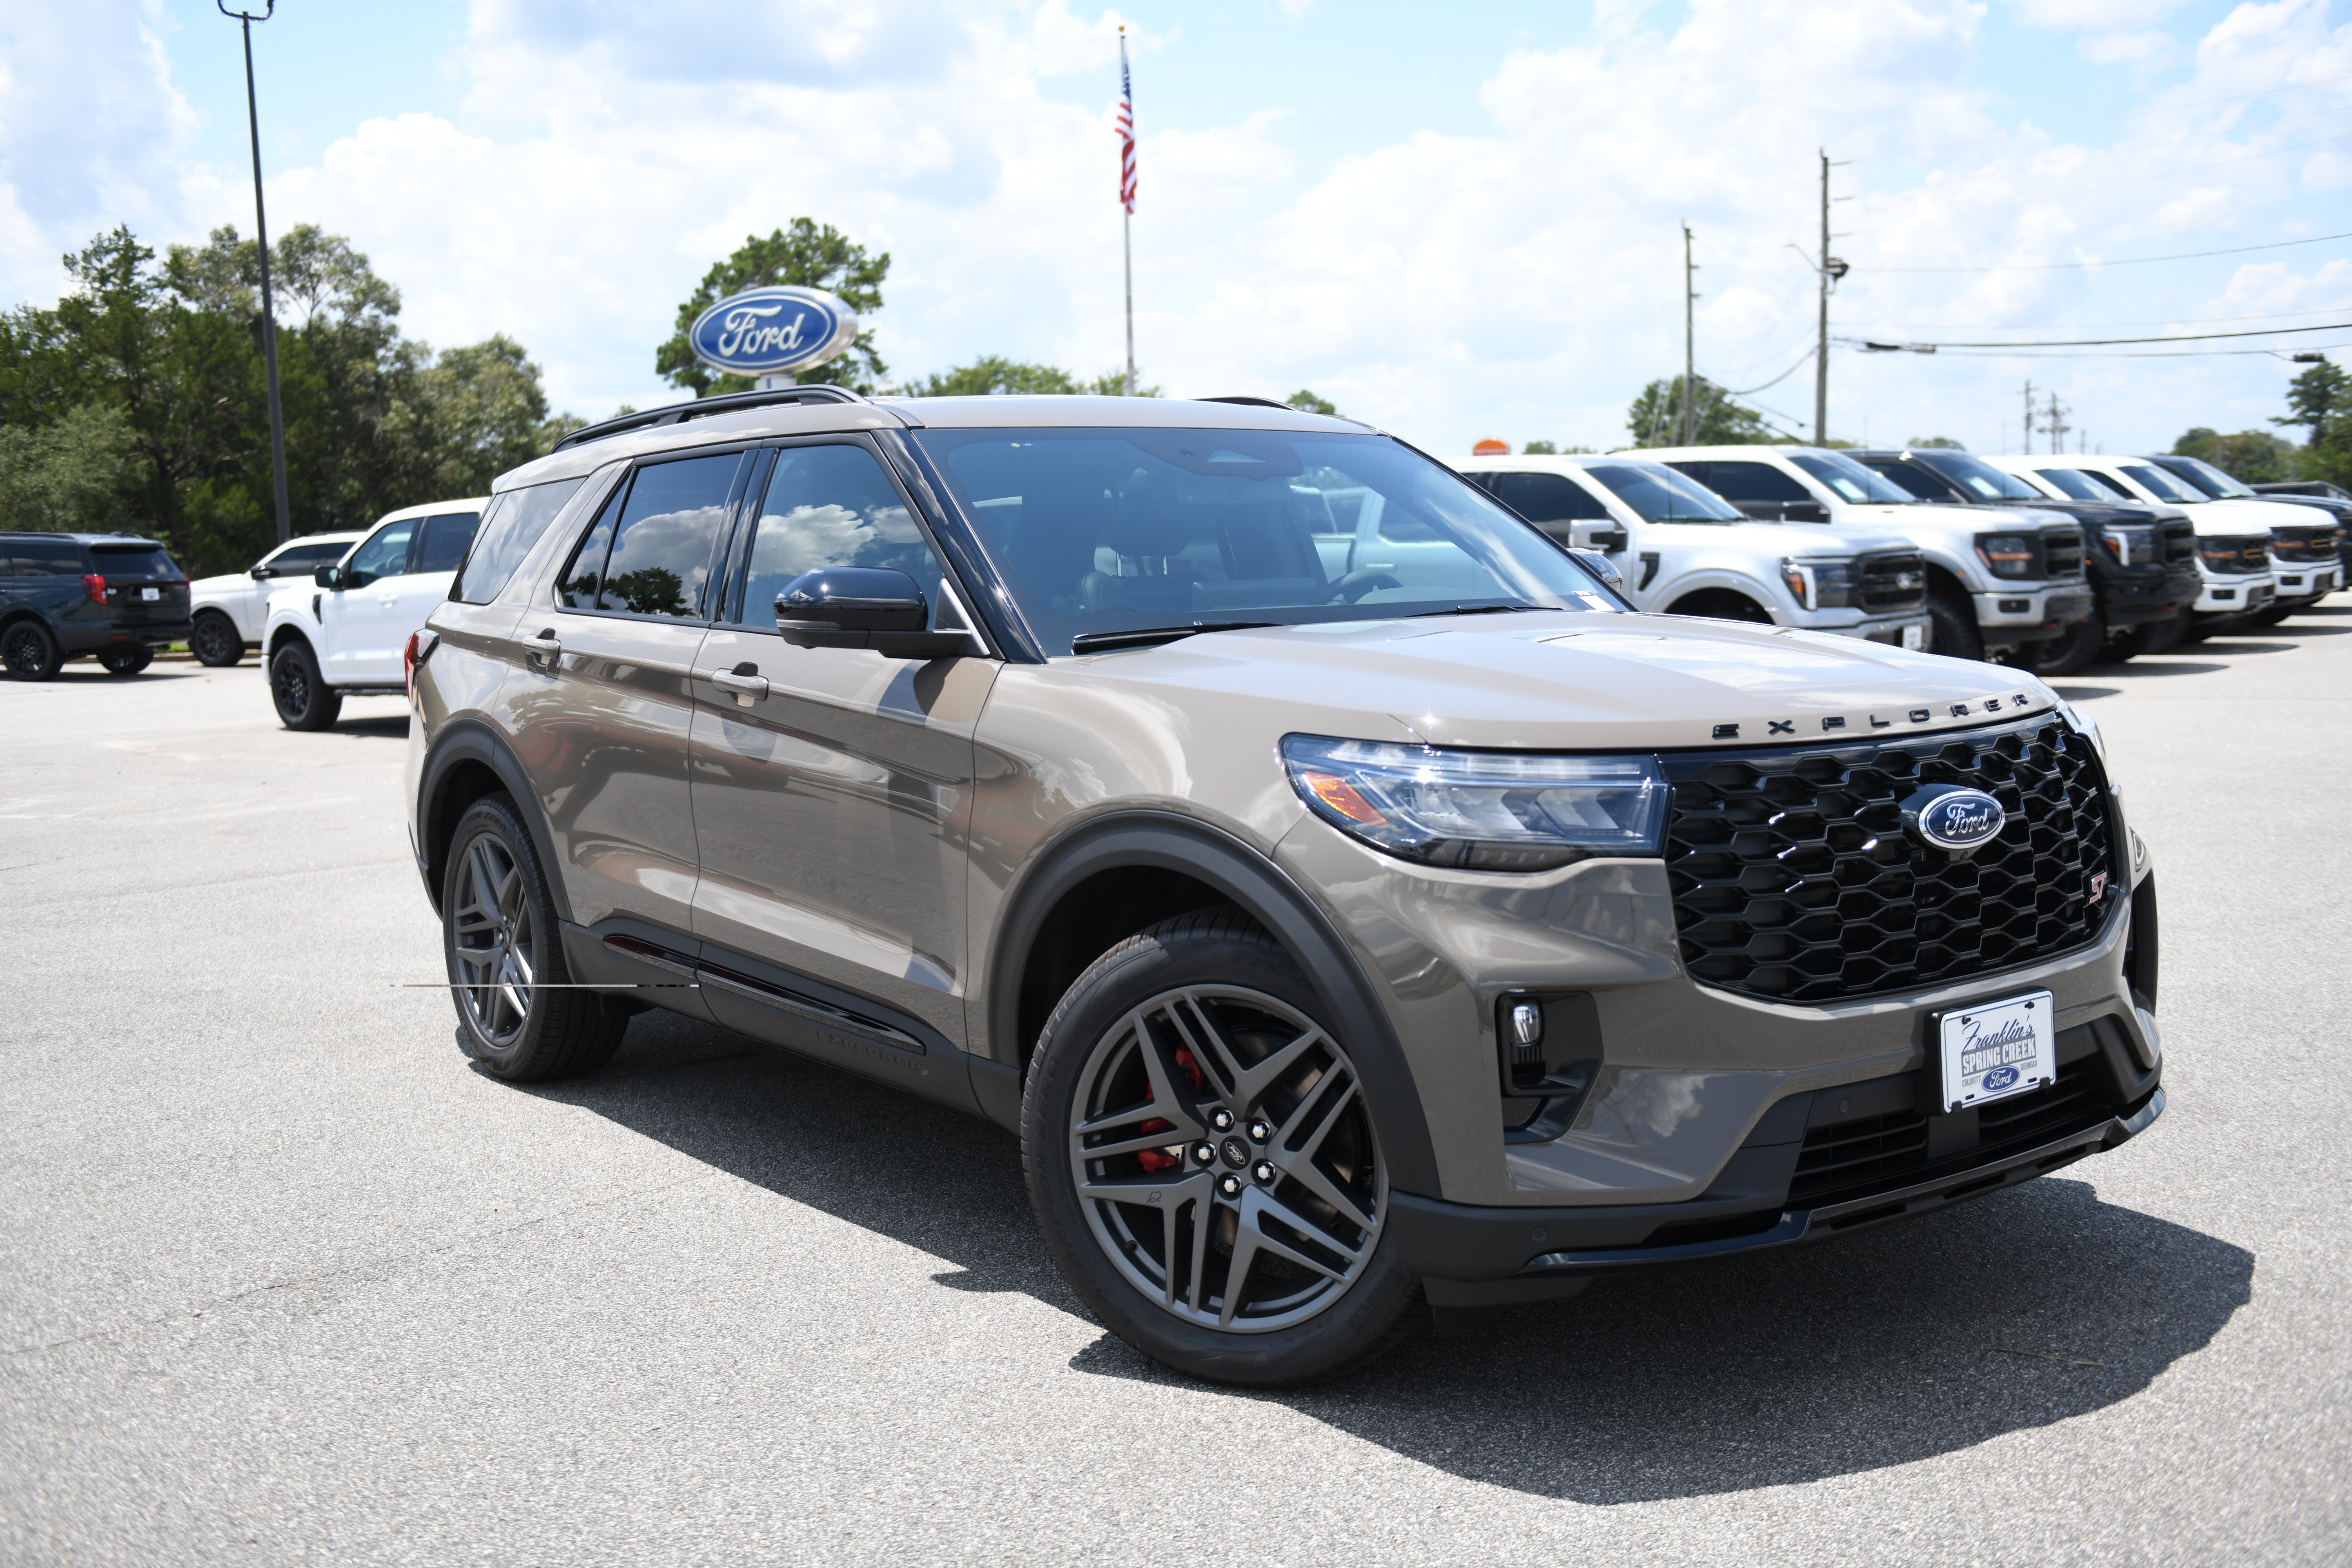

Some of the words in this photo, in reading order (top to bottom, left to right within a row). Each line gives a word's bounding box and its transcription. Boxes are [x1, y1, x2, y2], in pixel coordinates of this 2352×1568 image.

[719, 305, 805, 356] Ford
[1712, 693, 2029, 739] EXPLORER
[484, 812, 506, 831] ZERO
[1945, 803, 1989, 835] Ford
[2089, 871, 2107, 904] ST
[816, 1030, 920, 1070] EXPLORER
[1962, 1014, 2034, 1054] Franklin's
[1963, 1047, 2000, 1074] SPRING
[2002, 1037, 2036, 1064] CREEK
[2020, 1060, 2037, 1070] GEORGIA
[1962, 1075, 1981, 1087] COLQUITT
[1989, 1069, 2012, 1088] Ford
[1035, 1055, 1057, 1138] ZERO
[1229, 1145, 1243, 1160] Ford
[1147, 1191, 1162, 1204] 12
